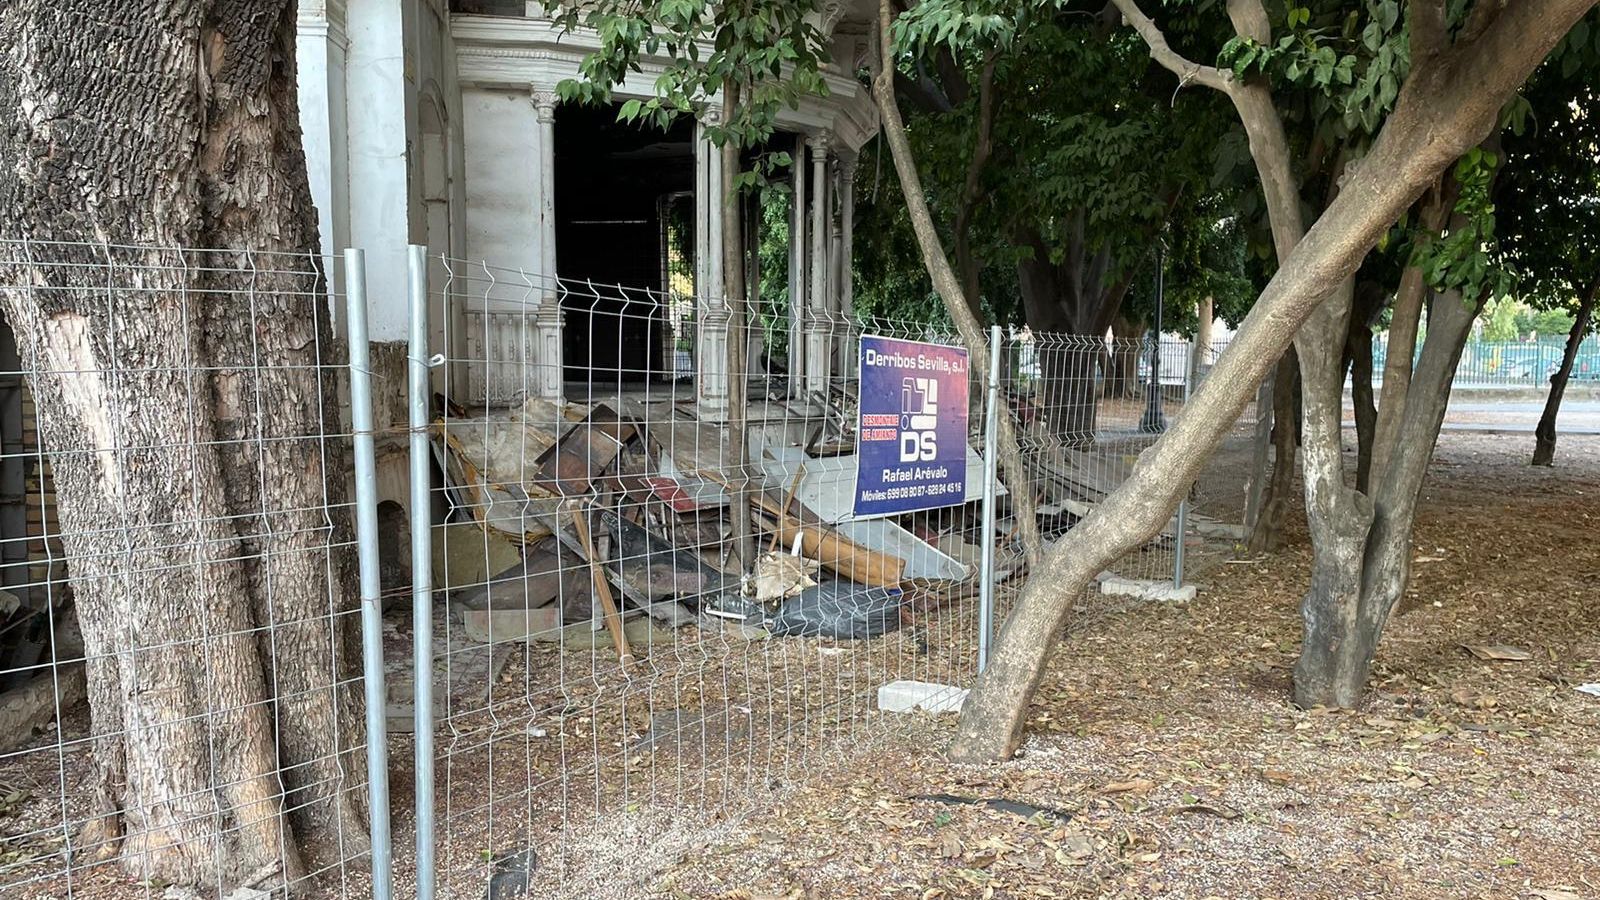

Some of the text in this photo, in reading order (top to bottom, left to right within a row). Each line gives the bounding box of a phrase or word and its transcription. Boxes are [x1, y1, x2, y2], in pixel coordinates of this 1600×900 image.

[866, 349, 916, 369] Derribos
[918, 354, 951, 375] Sevilla,
[862, 429, 897, 441] DE AMIANTO
[900, 431, 937, 462] DS
[882, 466, 948, 482] Rafael Arévalo
